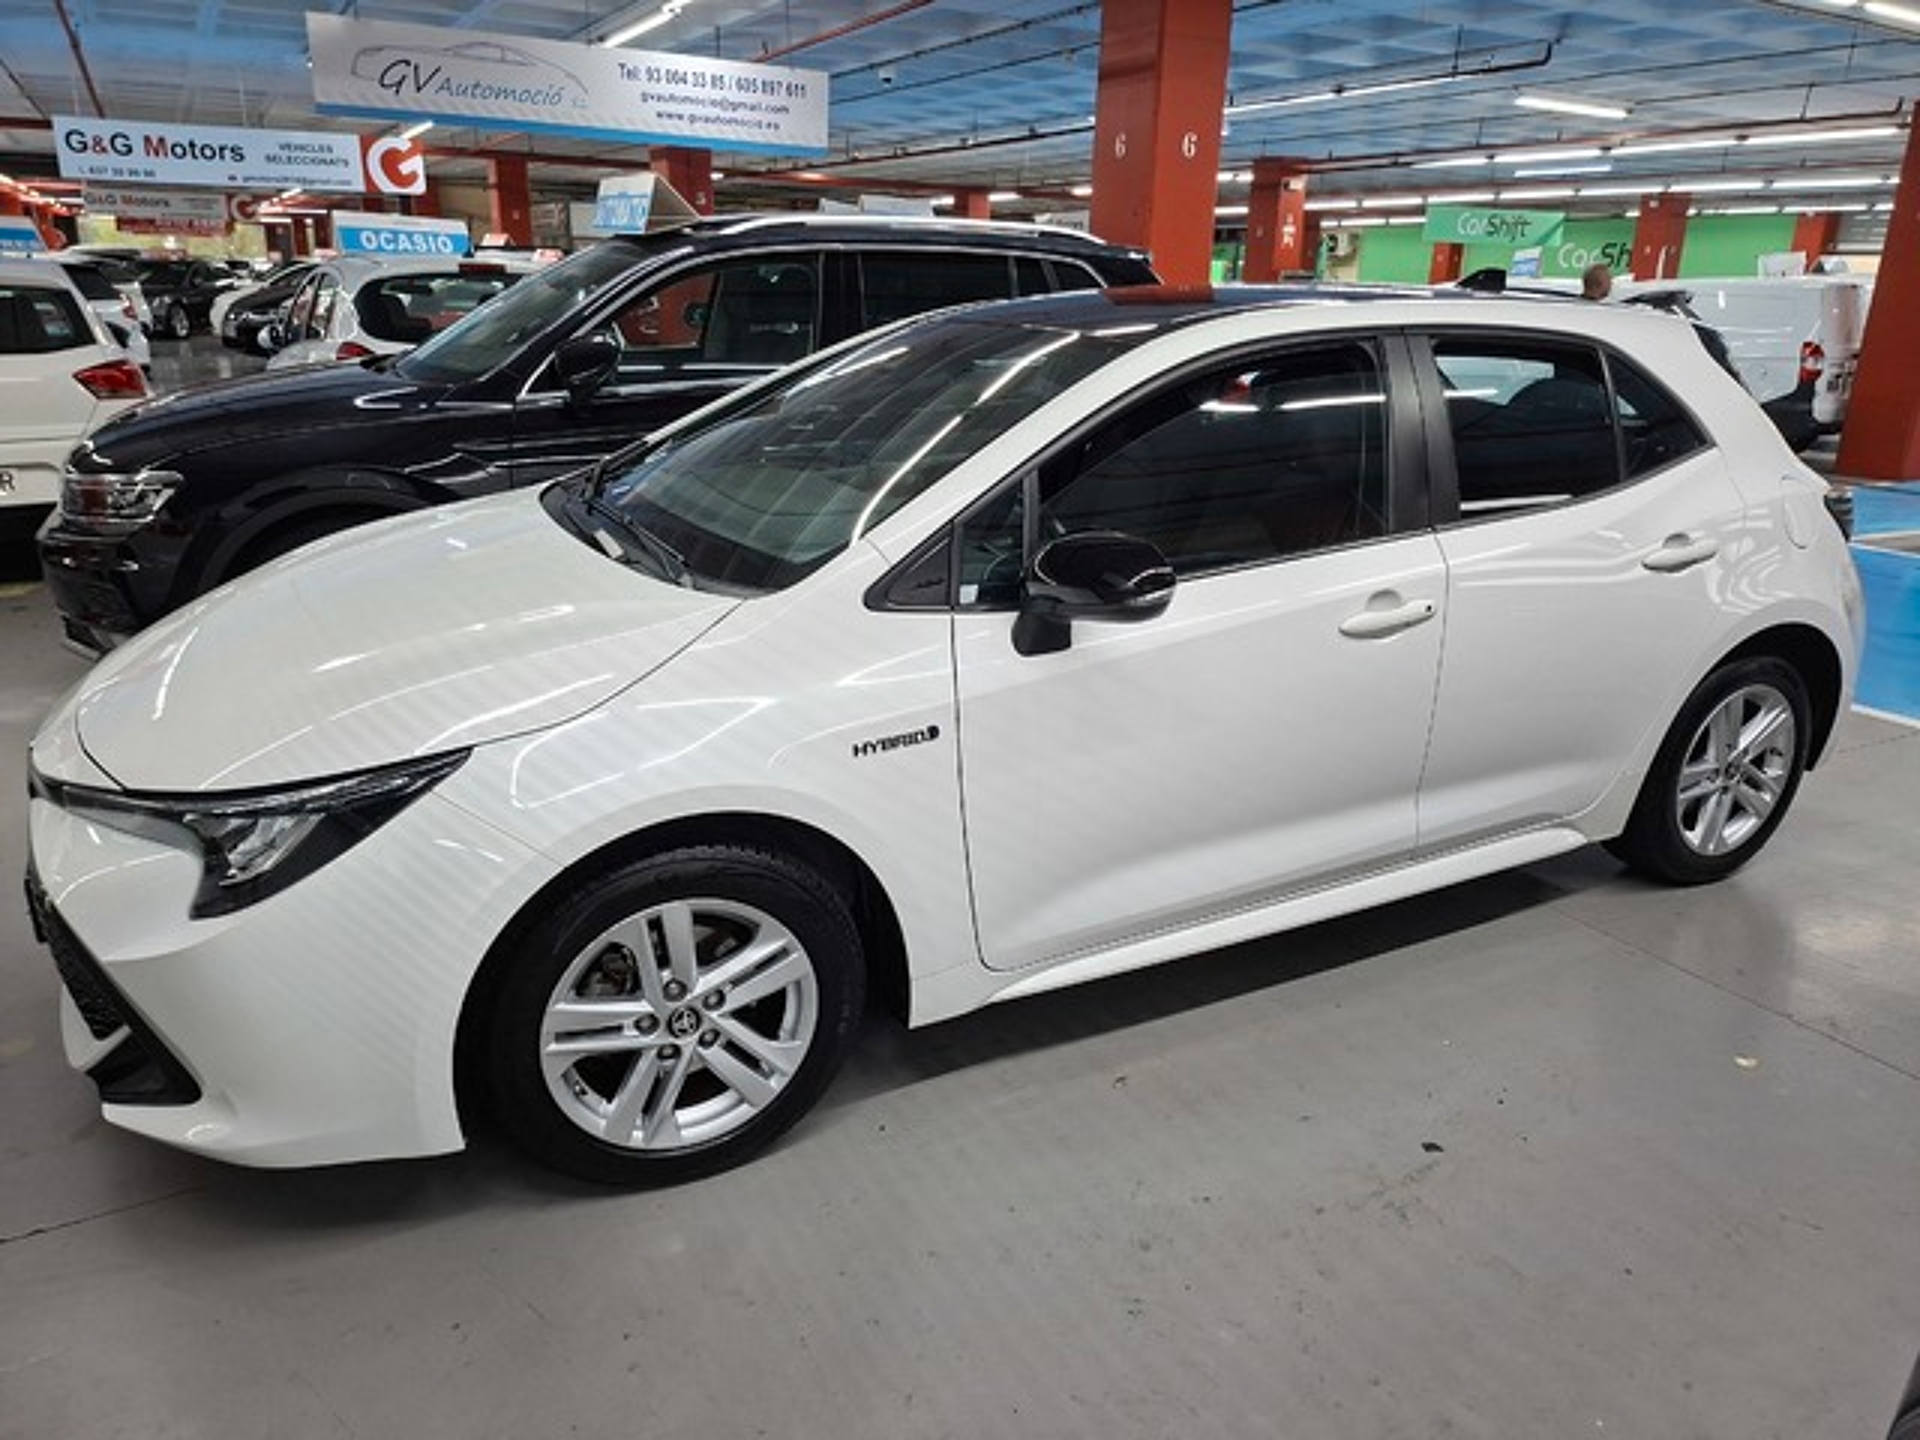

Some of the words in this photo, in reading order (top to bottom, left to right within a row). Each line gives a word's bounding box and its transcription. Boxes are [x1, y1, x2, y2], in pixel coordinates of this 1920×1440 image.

[378, 59, 442, 96] GV
[65, 129, 133, 157] G&G
[143, 134, 246, 163] Motors
[1115, 133, 1126, 158] 6
[1182, 132, 1198, 158] 6
[1457, 211, 1532, 243] CarShift
[1558, 241, 1633, 269] CarSh
[852, 730, 928, 758] HYBRID
